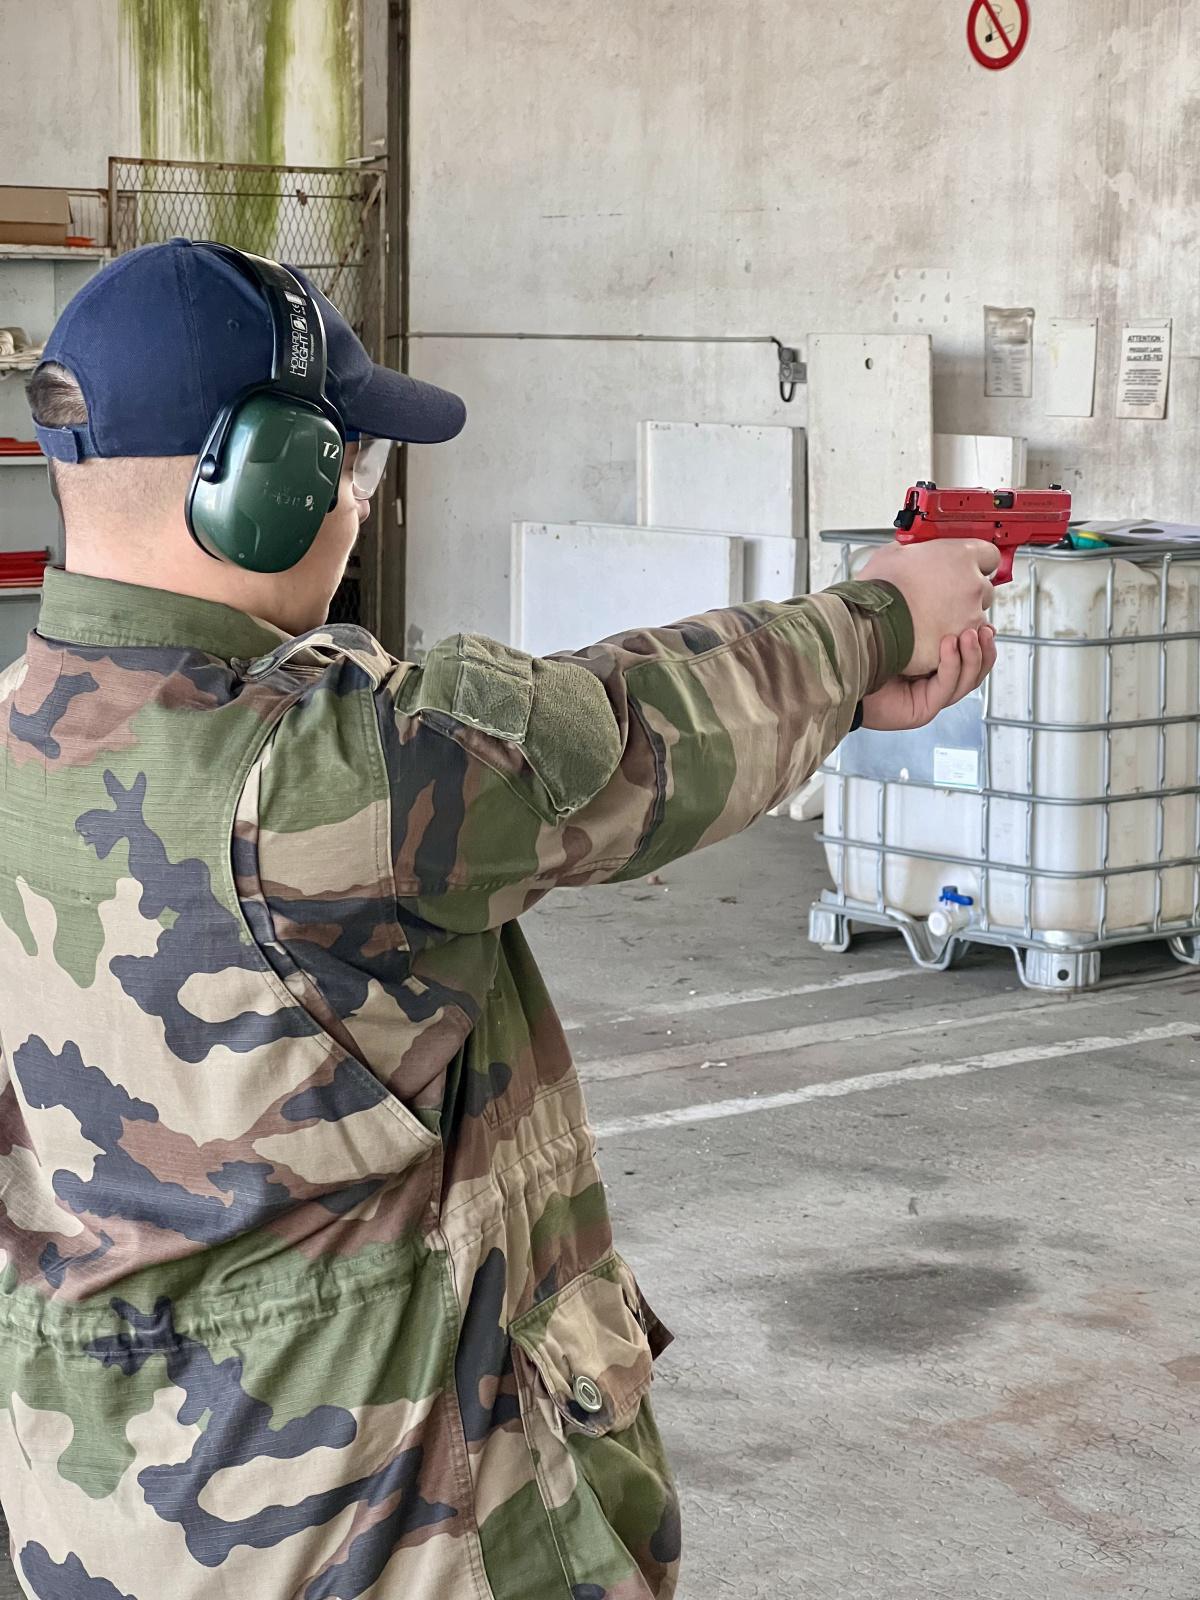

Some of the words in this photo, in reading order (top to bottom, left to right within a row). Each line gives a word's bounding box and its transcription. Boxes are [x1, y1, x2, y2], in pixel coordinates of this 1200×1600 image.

[290, 330, 301, 375] HOWARD
[297, 332, 309, 377] LEIGHT
[323, 441, 340, 459] T2
